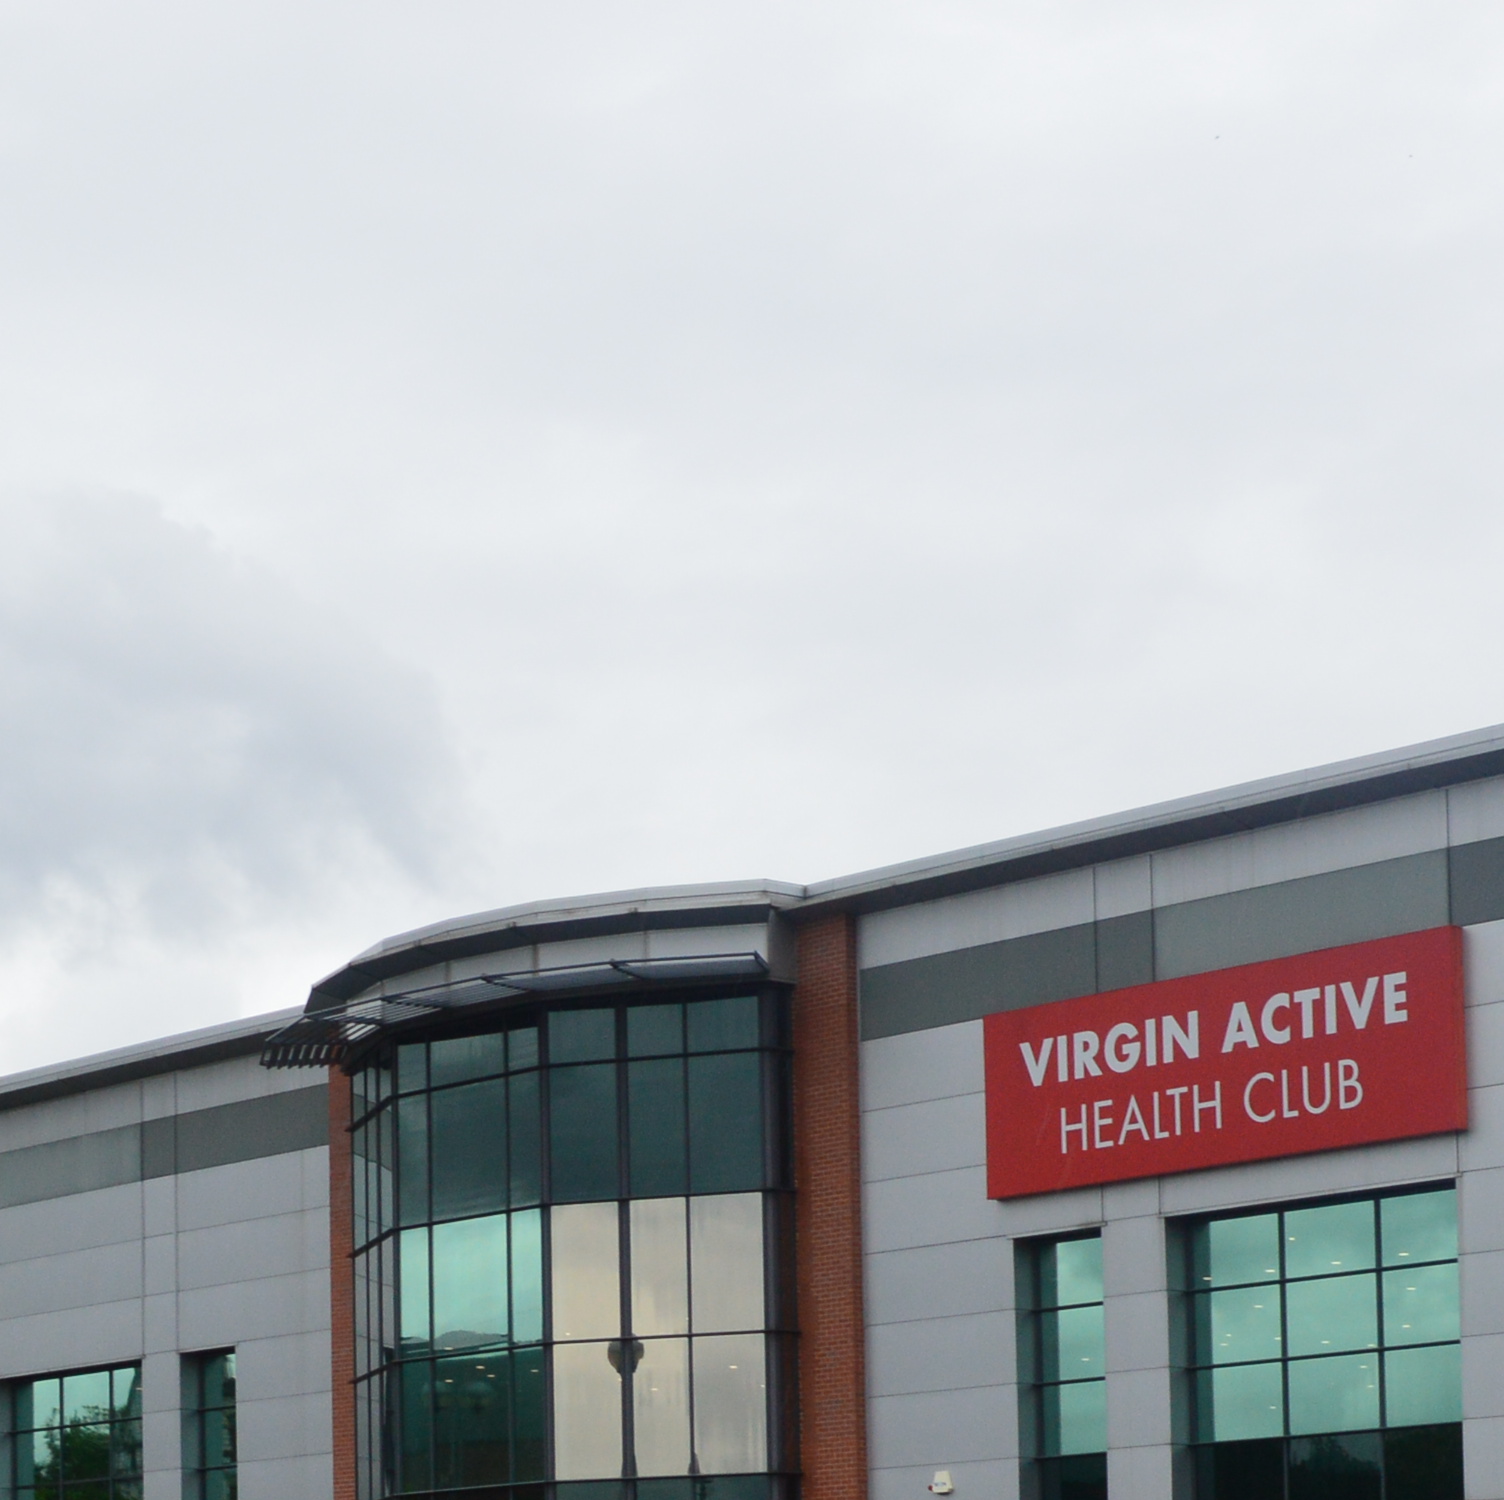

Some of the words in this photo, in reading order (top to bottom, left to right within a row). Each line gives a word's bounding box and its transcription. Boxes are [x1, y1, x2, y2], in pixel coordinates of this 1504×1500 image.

[1019, 1010, 1200, 1088] VIRGIN
[1221, 970, 1409, 1054] ACTIVE
[1060, 1080, 1223, 1155] HEALTH
[1243, 1058, 1364, 1123] CLUB
